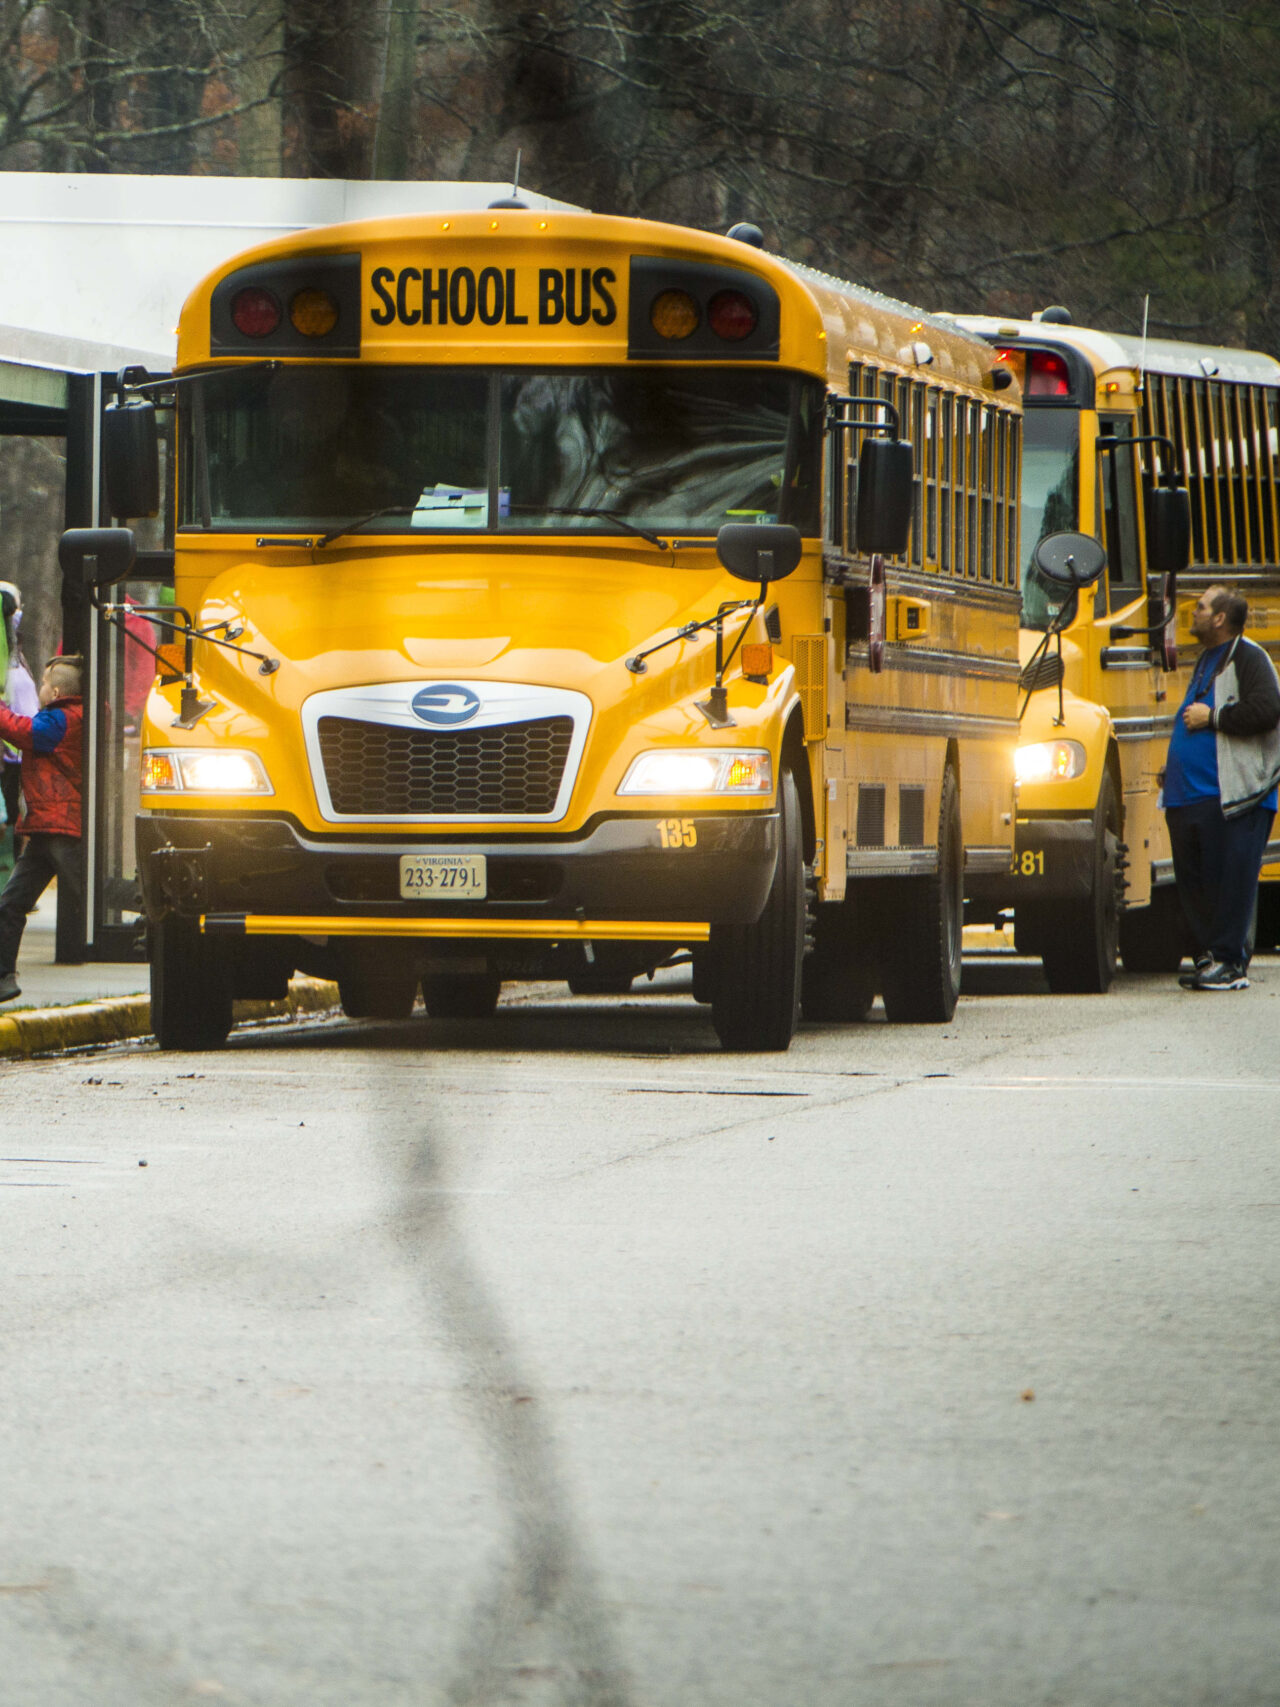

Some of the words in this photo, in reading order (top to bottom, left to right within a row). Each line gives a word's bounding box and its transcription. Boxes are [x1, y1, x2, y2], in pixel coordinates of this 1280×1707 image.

[370, 267, 528, 326] SCHOOL
[538, 267, 617, 326] BUS
[656, 818, 698, 849] 135
[422, 857, 463, 865] VIRGINIA
